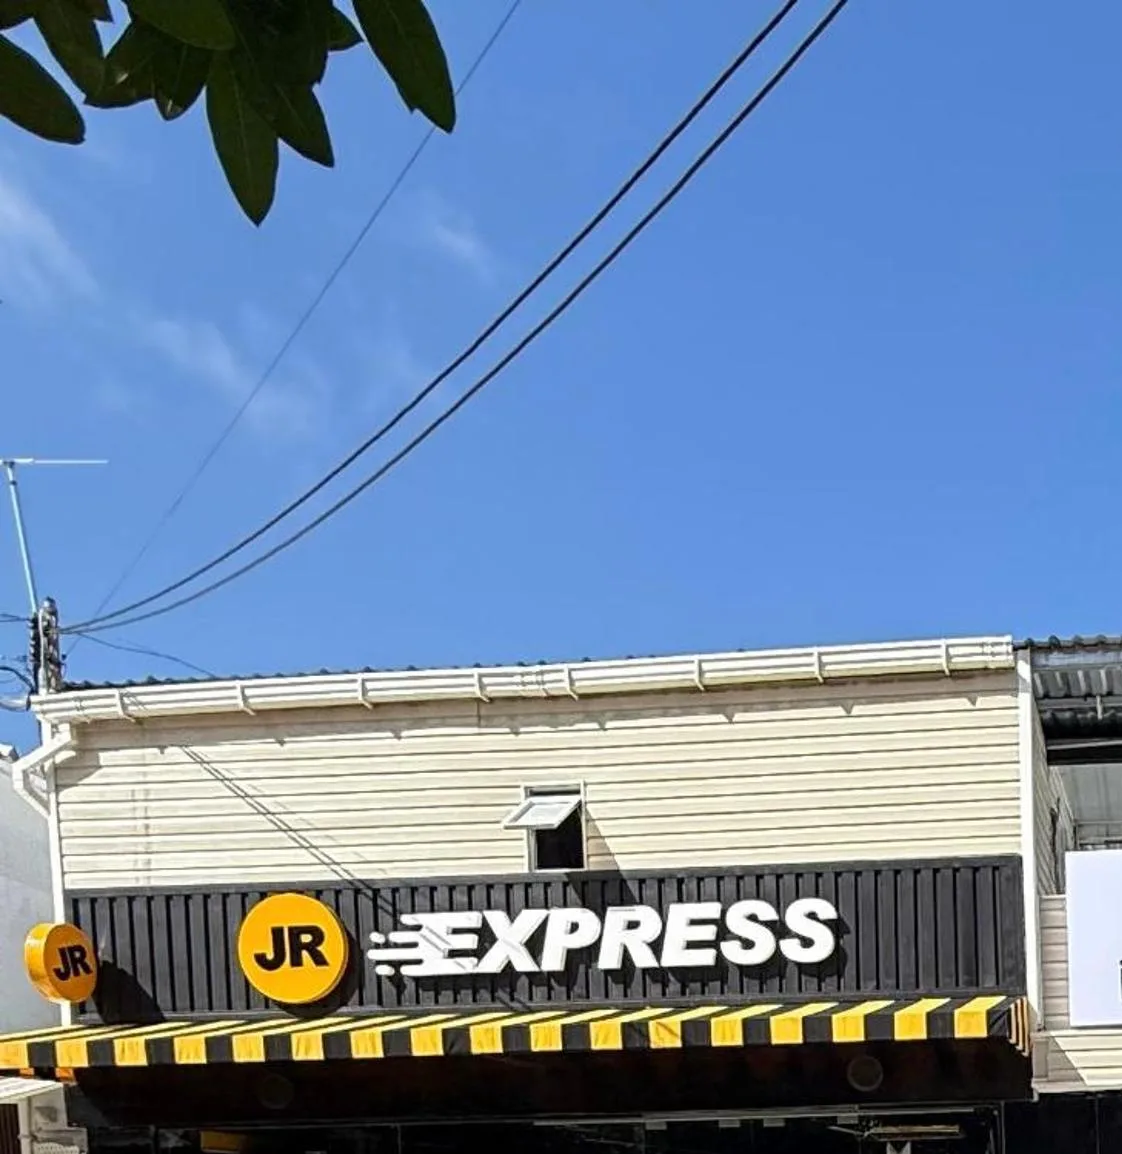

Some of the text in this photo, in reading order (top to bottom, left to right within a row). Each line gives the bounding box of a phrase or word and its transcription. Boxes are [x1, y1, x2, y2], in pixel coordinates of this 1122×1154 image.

[53, 945, 93, 982] JR
[253, 898, 840, 976] JR EXPRESS
